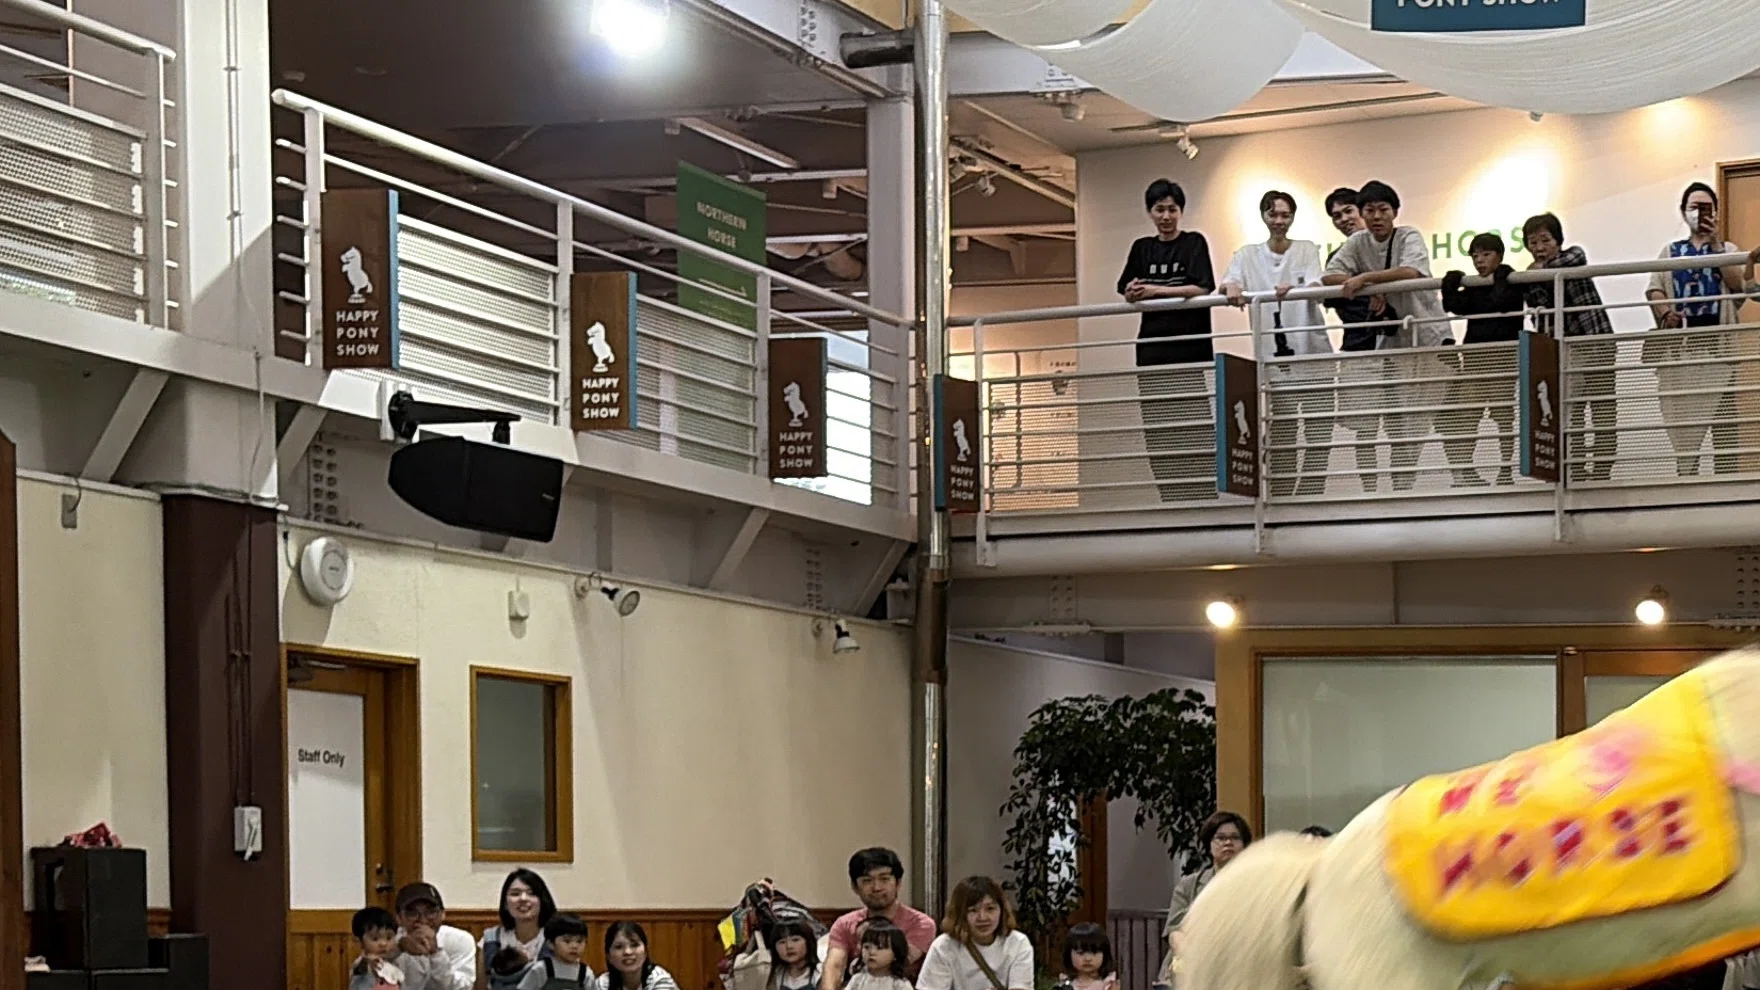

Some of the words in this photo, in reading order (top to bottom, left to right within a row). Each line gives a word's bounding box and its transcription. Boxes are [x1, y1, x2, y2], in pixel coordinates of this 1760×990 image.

[696, 201, 747, 231] NORTHERN
[335, 309, 380, 323] HAPPY
[336, 326, 380, 339] PONY
[336, 343, 380, 357] SHOW
[582, 377, 620, 390] HAPPY
[582, 392, 620, 404] PONY
[583, 406, 620, 419] SHOW
[779, 431, 814, 442] HAPPY
[779, 445, 814, 456] PONY
[779, 458, 814, 469] SHOW
[298, 748, 320, 763] Staff
[323, 749, 345, 769] Only
